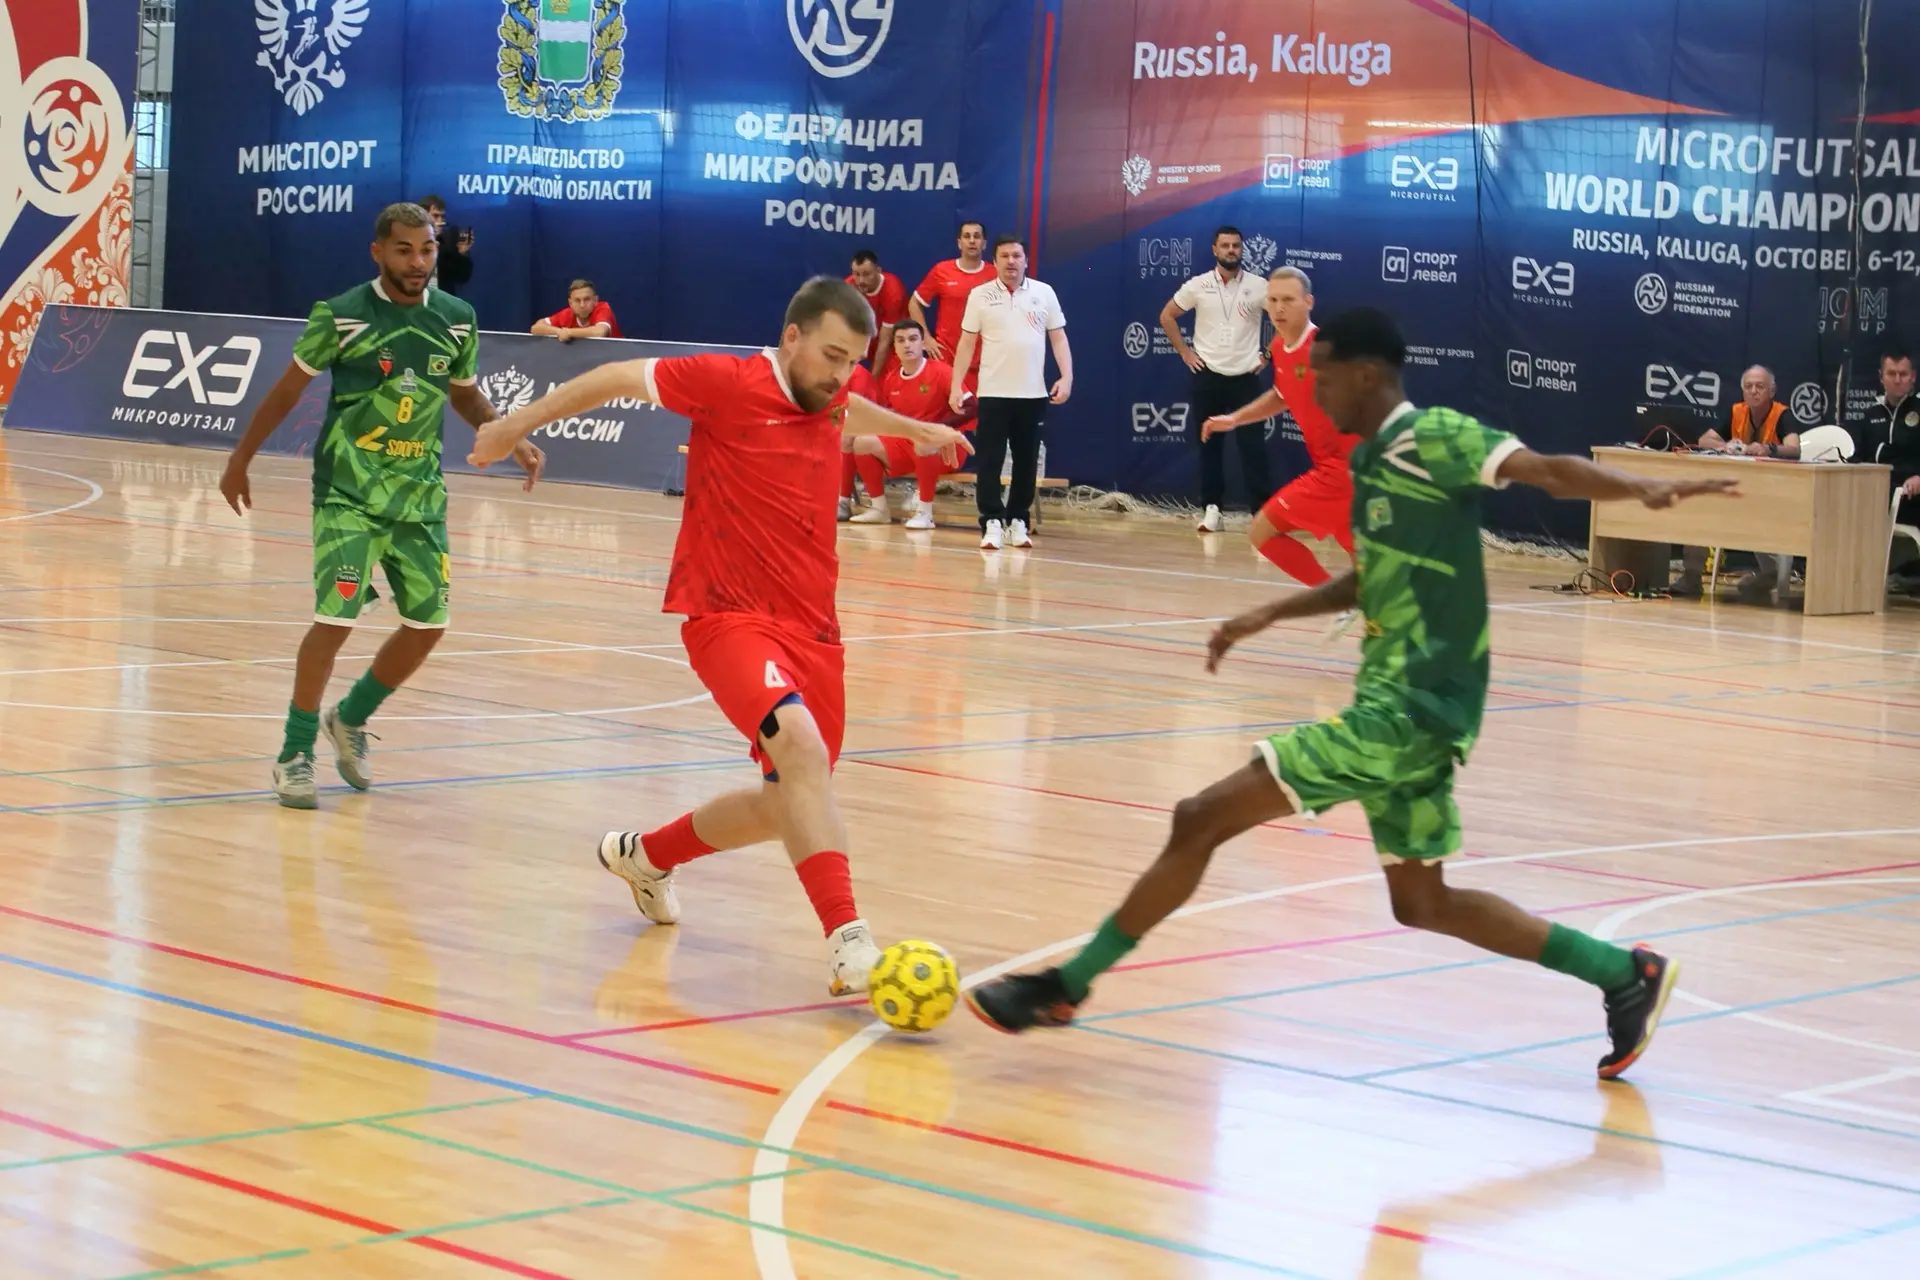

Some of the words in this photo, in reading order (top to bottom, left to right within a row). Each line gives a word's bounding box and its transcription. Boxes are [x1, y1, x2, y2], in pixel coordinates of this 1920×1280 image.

[1134, 31, 1258, 82] Russia,
[1271, 33, 1391, 86] Kaluga
[735, 111, 923, 151] ФЕДЕРАЦИЯ
[238, 140, 377, 174] МИНСПОРТ
[487, 144, 625, 169] ПРАВИТЕЛЬСТВО
[1635, 126, 1920, 178] MICROFUTSAL
[703, 152, 960, 192] МИКРОФУТЗАЛА
[257, 184, 353, 215] РОССИИ
[458, 174, 562, 200] КАЛУЖСКОЙ
[566, 180, 652, 200] ОБЛАСТИ
[1390, 190, 1456, 202] MICROFUTSAL
[1545, 172, 1680, 220] WORLD
[765, 199, 875, 235] РОССИИ
[1413, 252, 1457, 269] спорт
[1573, 228, 1650, 261] RUSSIA,
[1656, 236, 1748, 270] KALUGA,
[1140, 267, 1191, 279] group
[1412, 270, 1457, 283] левел
[1675, 281, 1715, 293] RUSSIAN
[1513, 293, 1573, 308] MICROFUTSAL
[1673, 292, 1739, 308] MICROFUTSAL
[1673, 304, 1731, 318] FEDERATION
[1817, 320, 1886, 334] grup
[1414, 356, 1439, 365] RUSSIA
[1435, 348, 1446, 356] OF
[1447, 349, 1475, 359] SPORTS
[1535, 358, 1577, 378] спорт
[1535, 376, 1577, 392] левел
[111, 406, 236, 432] МИКРОФУТЗАЛ
[397, 396, 413, 423] 8
[764, 660, 788, 688] 4
